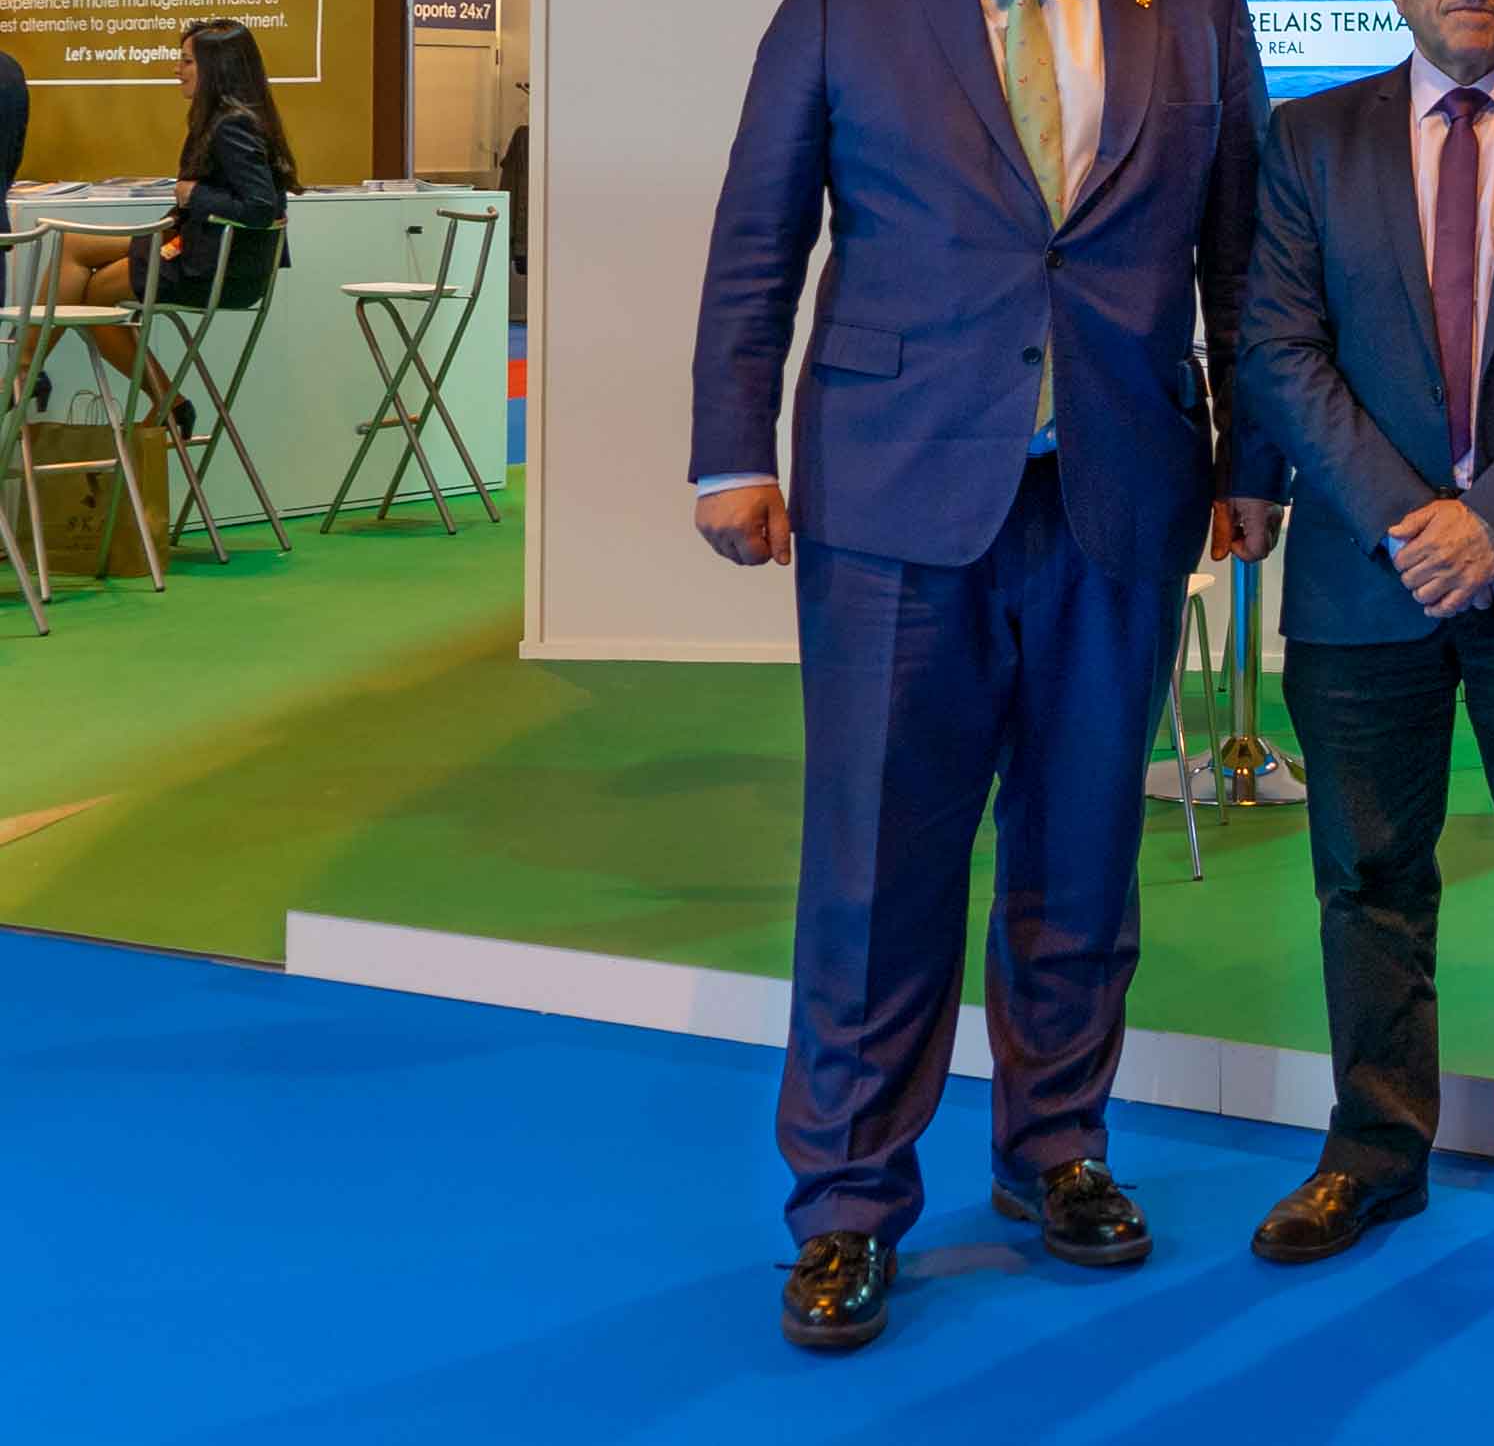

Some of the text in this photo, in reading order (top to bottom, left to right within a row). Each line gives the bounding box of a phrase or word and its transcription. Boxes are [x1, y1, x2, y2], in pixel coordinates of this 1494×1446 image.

[415, 2, 491, 21] oporte 24x7
[0, 18, 17, 32] est
[20, 17, 88, 32] alternative
[90, 17, 103, 31] to
[107, 14, 176, 34] guarantee
[1331, 11, 1413, 32] TERMA
[65, 45, 182, 64] Let's work together
[1269, 42, 1304, 54] REAL
